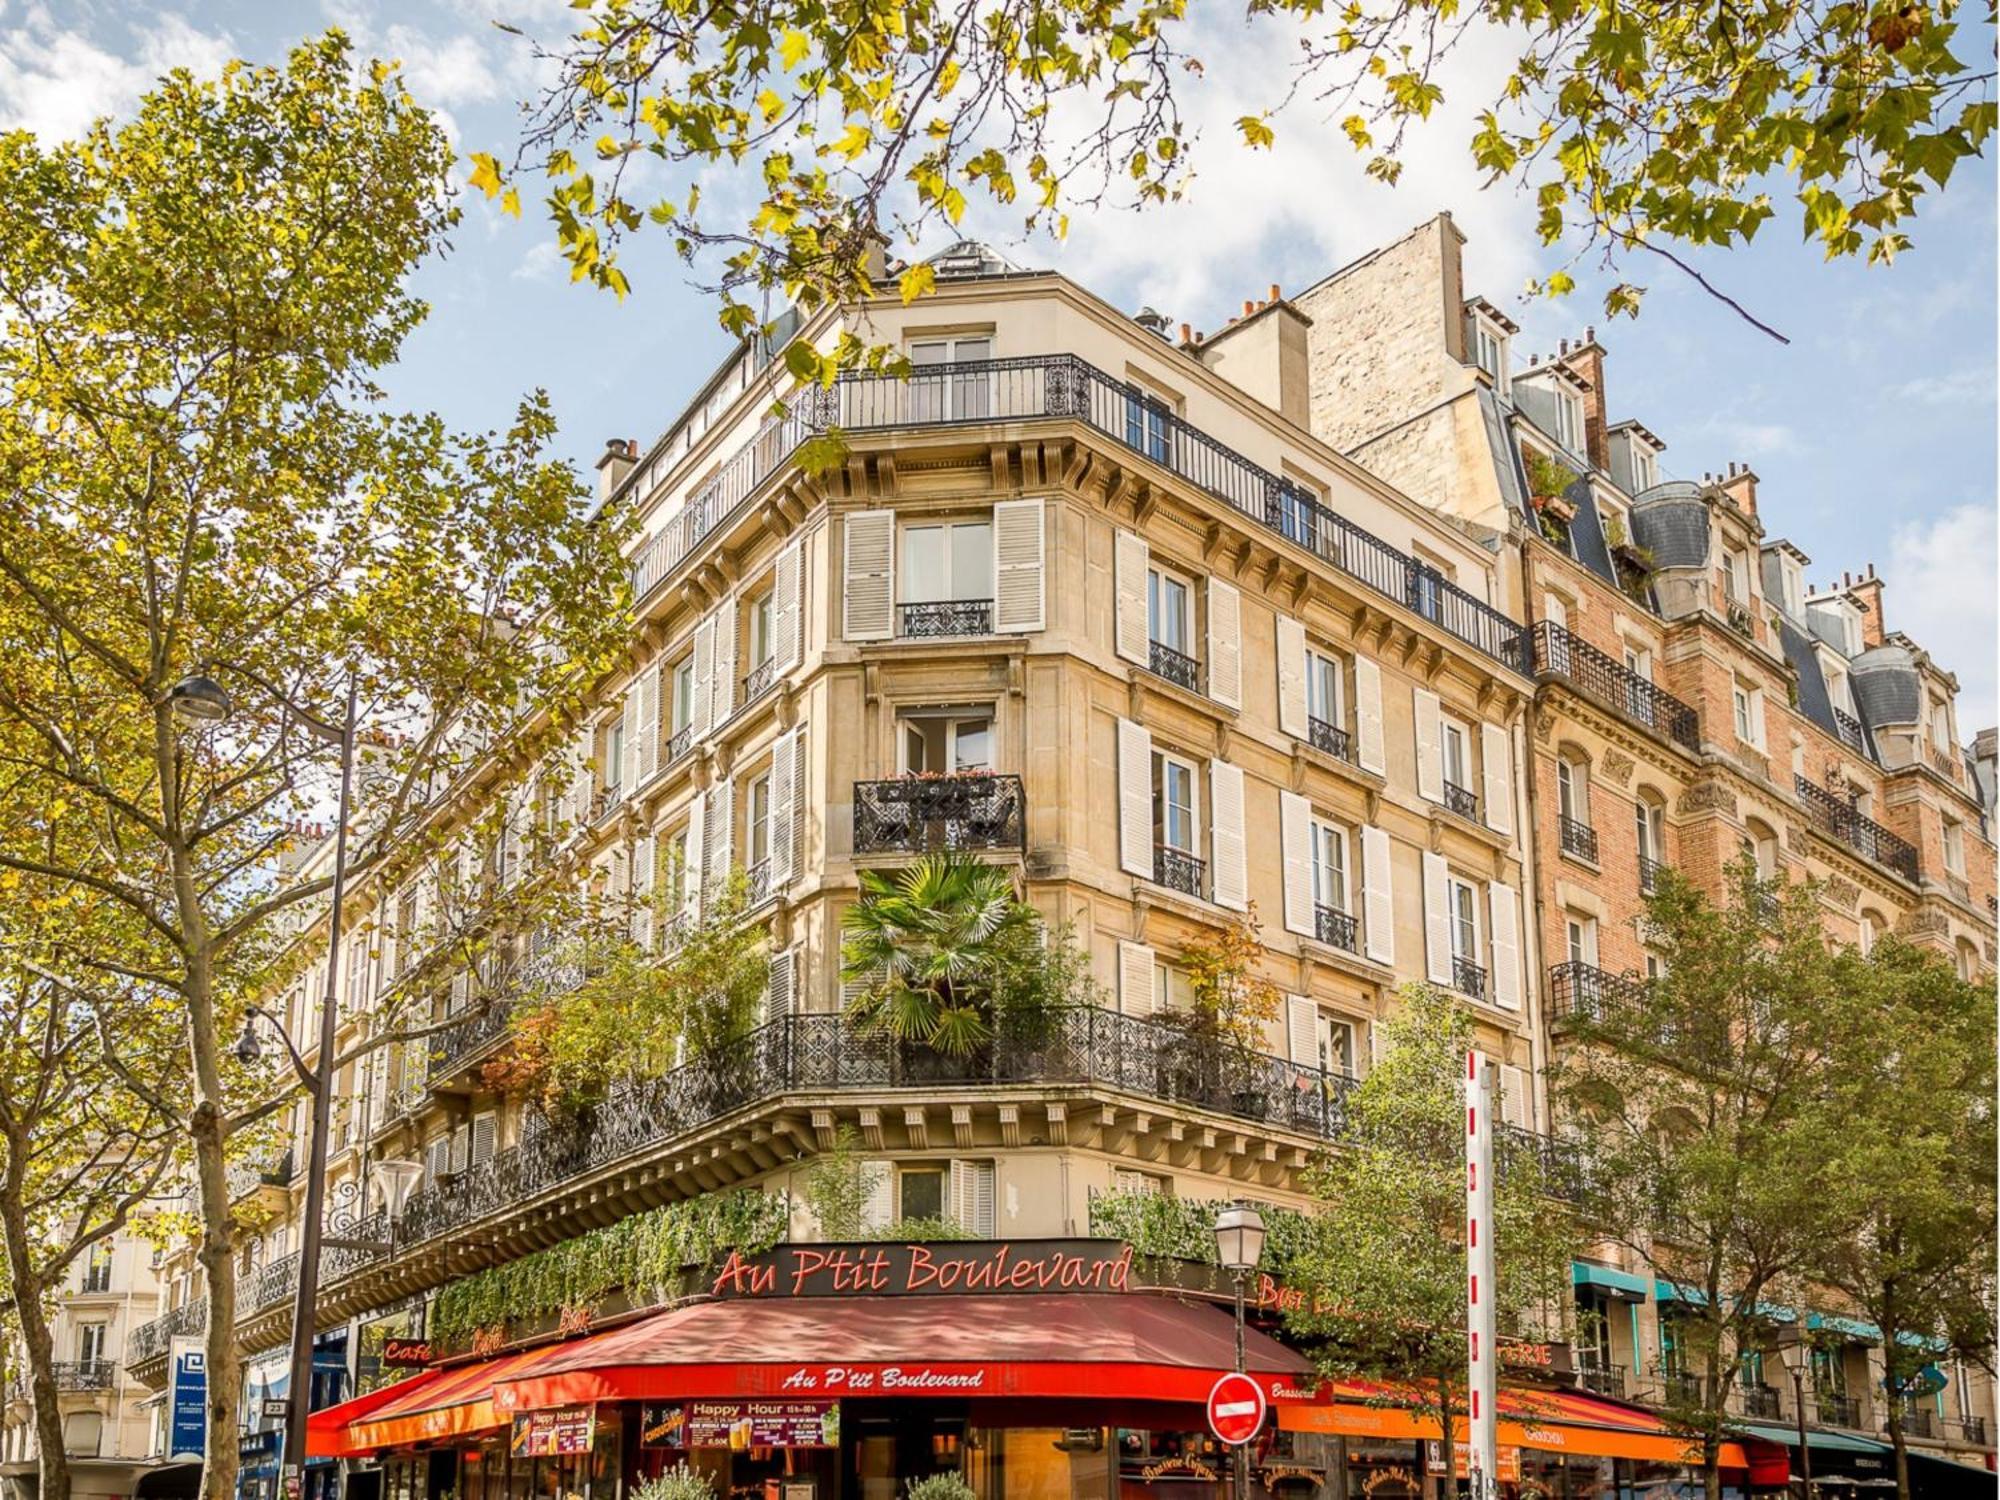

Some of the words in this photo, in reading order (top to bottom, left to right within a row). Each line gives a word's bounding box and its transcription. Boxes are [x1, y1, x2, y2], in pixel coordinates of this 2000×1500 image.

[713, 1248, 776, 1296] Au
[791, 1249, 891, 1296] P'tit
[905, 1244, 1135, 1294] Boulevard
[384, 1341, 433, 1362] Café
[782, 1369, 816, 1389] Au
[824, 1367, 873, 1388] P'tit
[881, 1368, 984, 1389] Boulevard
[270, 1403, 282, 1412] 23
[693, 1403, 741, 1417] Happy
[747, 1403, 783, 1415] Hour
[533, 1412, 555, 1426] Happy
[556, 1411, 572, 1421] Hour
